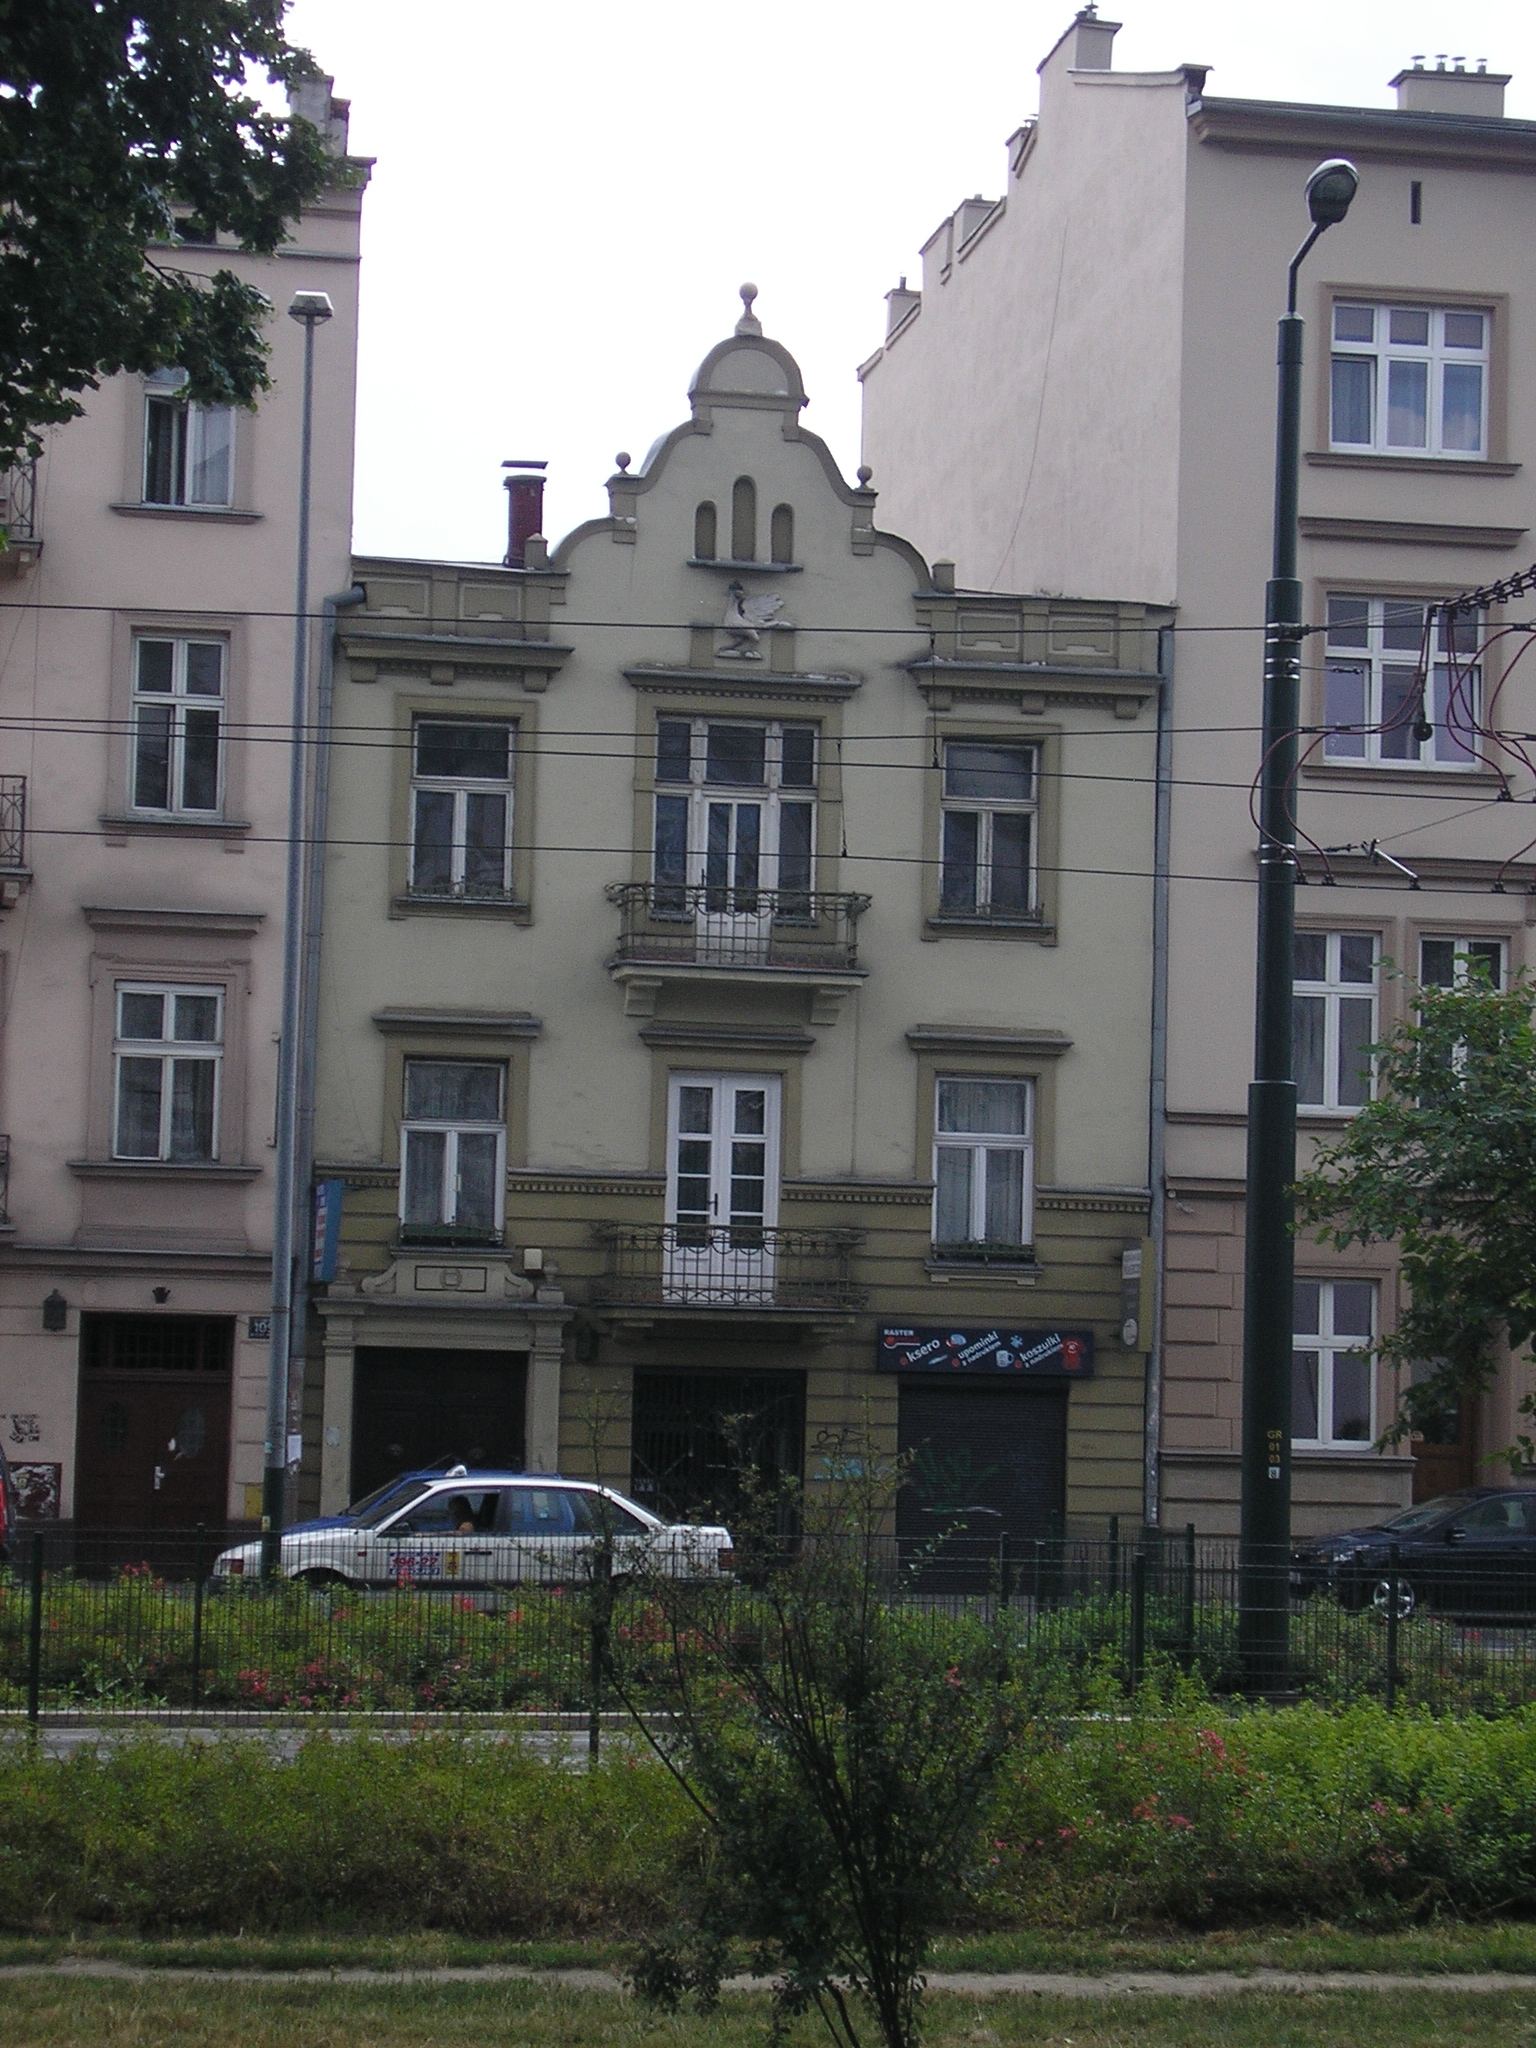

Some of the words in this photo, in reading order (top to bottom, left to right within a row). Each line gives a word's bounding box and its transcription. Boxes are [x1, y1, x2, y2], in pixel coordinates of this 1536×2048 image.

[884, 1329, 914, 1337] RASTER
[957, 1331, 999, 1360] upominki
[906, 1339, 941, 1362] ksero
[1019, 1333, 1061, 1362] koszulki
